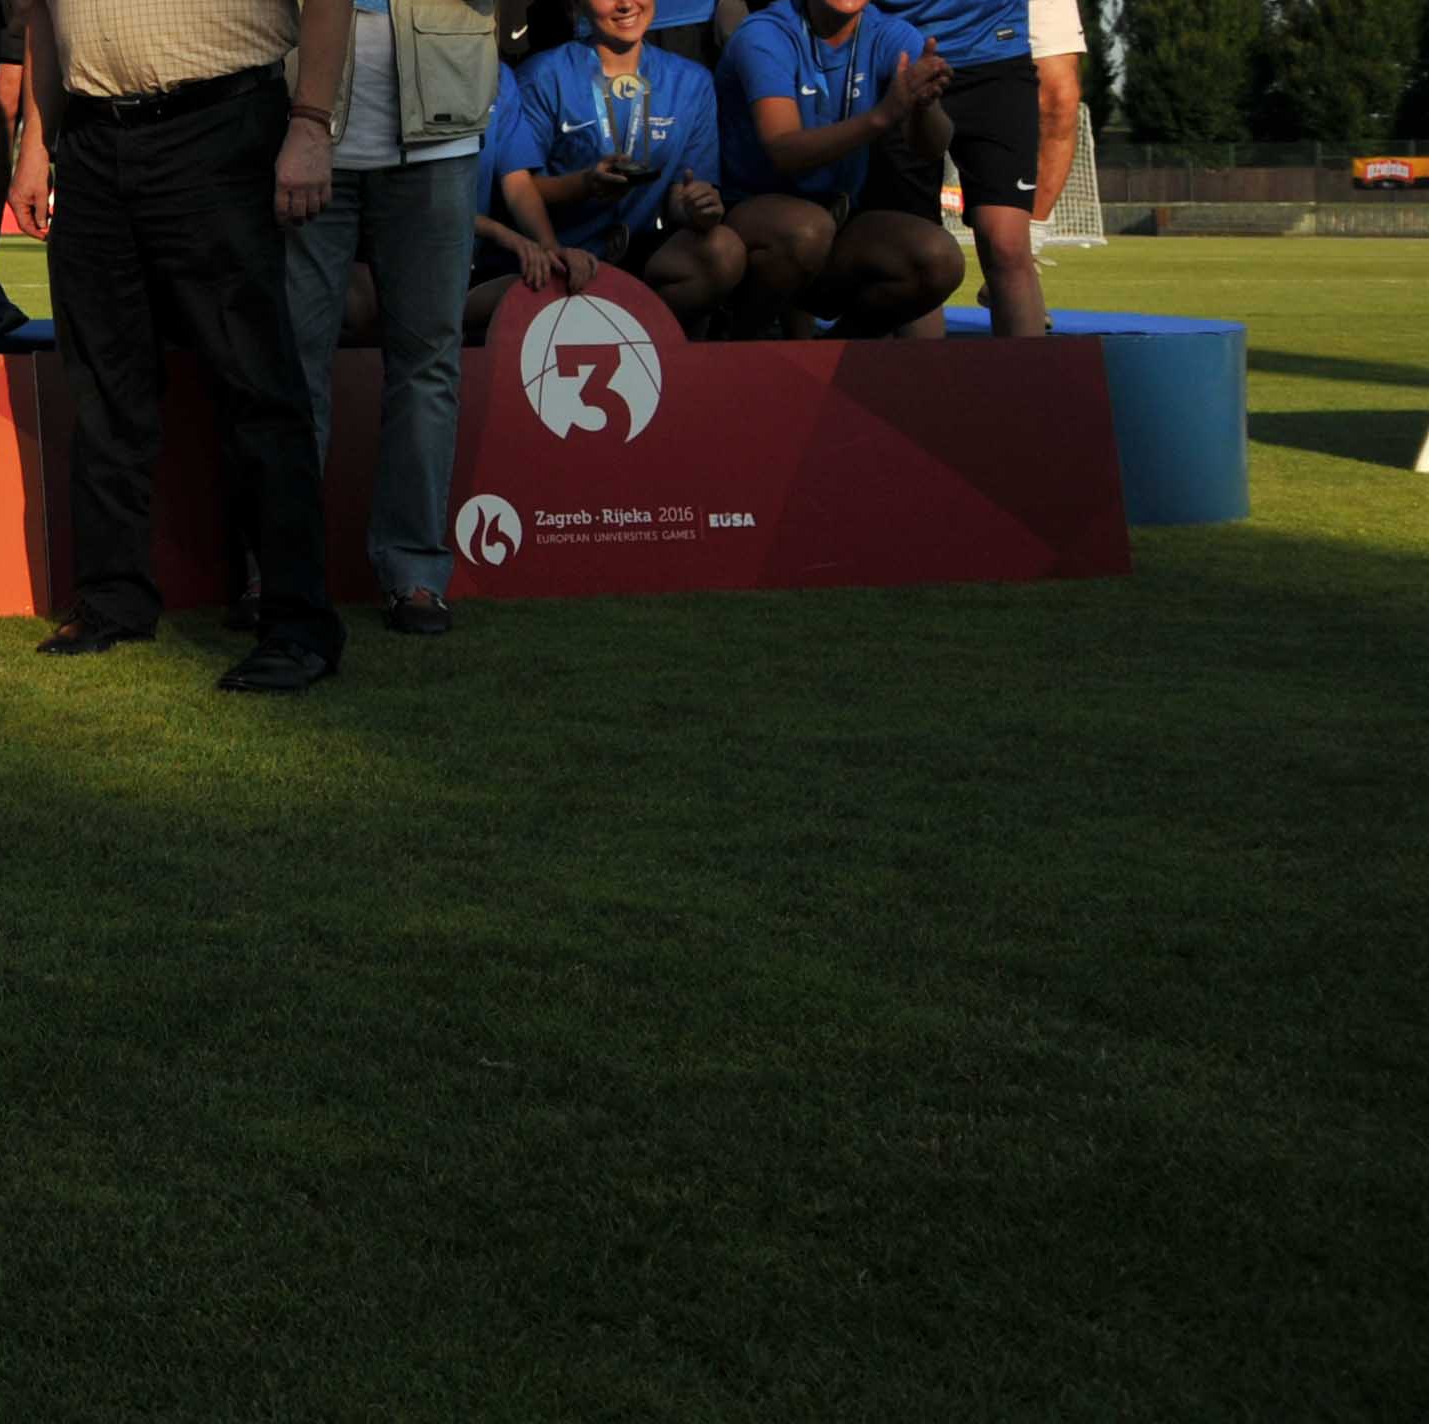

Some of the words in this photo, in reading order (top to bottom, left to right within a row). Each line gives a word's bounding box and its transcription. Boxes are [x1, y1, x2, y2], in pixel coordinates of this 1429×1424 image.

[555, 343, 634, 442] 3
[535, 509, 591, 529] Zagreb
[602, 507, 652, 527] Rijeka
[659, 506, 694, 523] 2016
[708, 512, 756, 528] EUSA
[536, 532, 590, 545] EUROPEAN
[594, 530, 658, 544] UNIVERSITIES
[662, 528, 696, 541] GAMES
